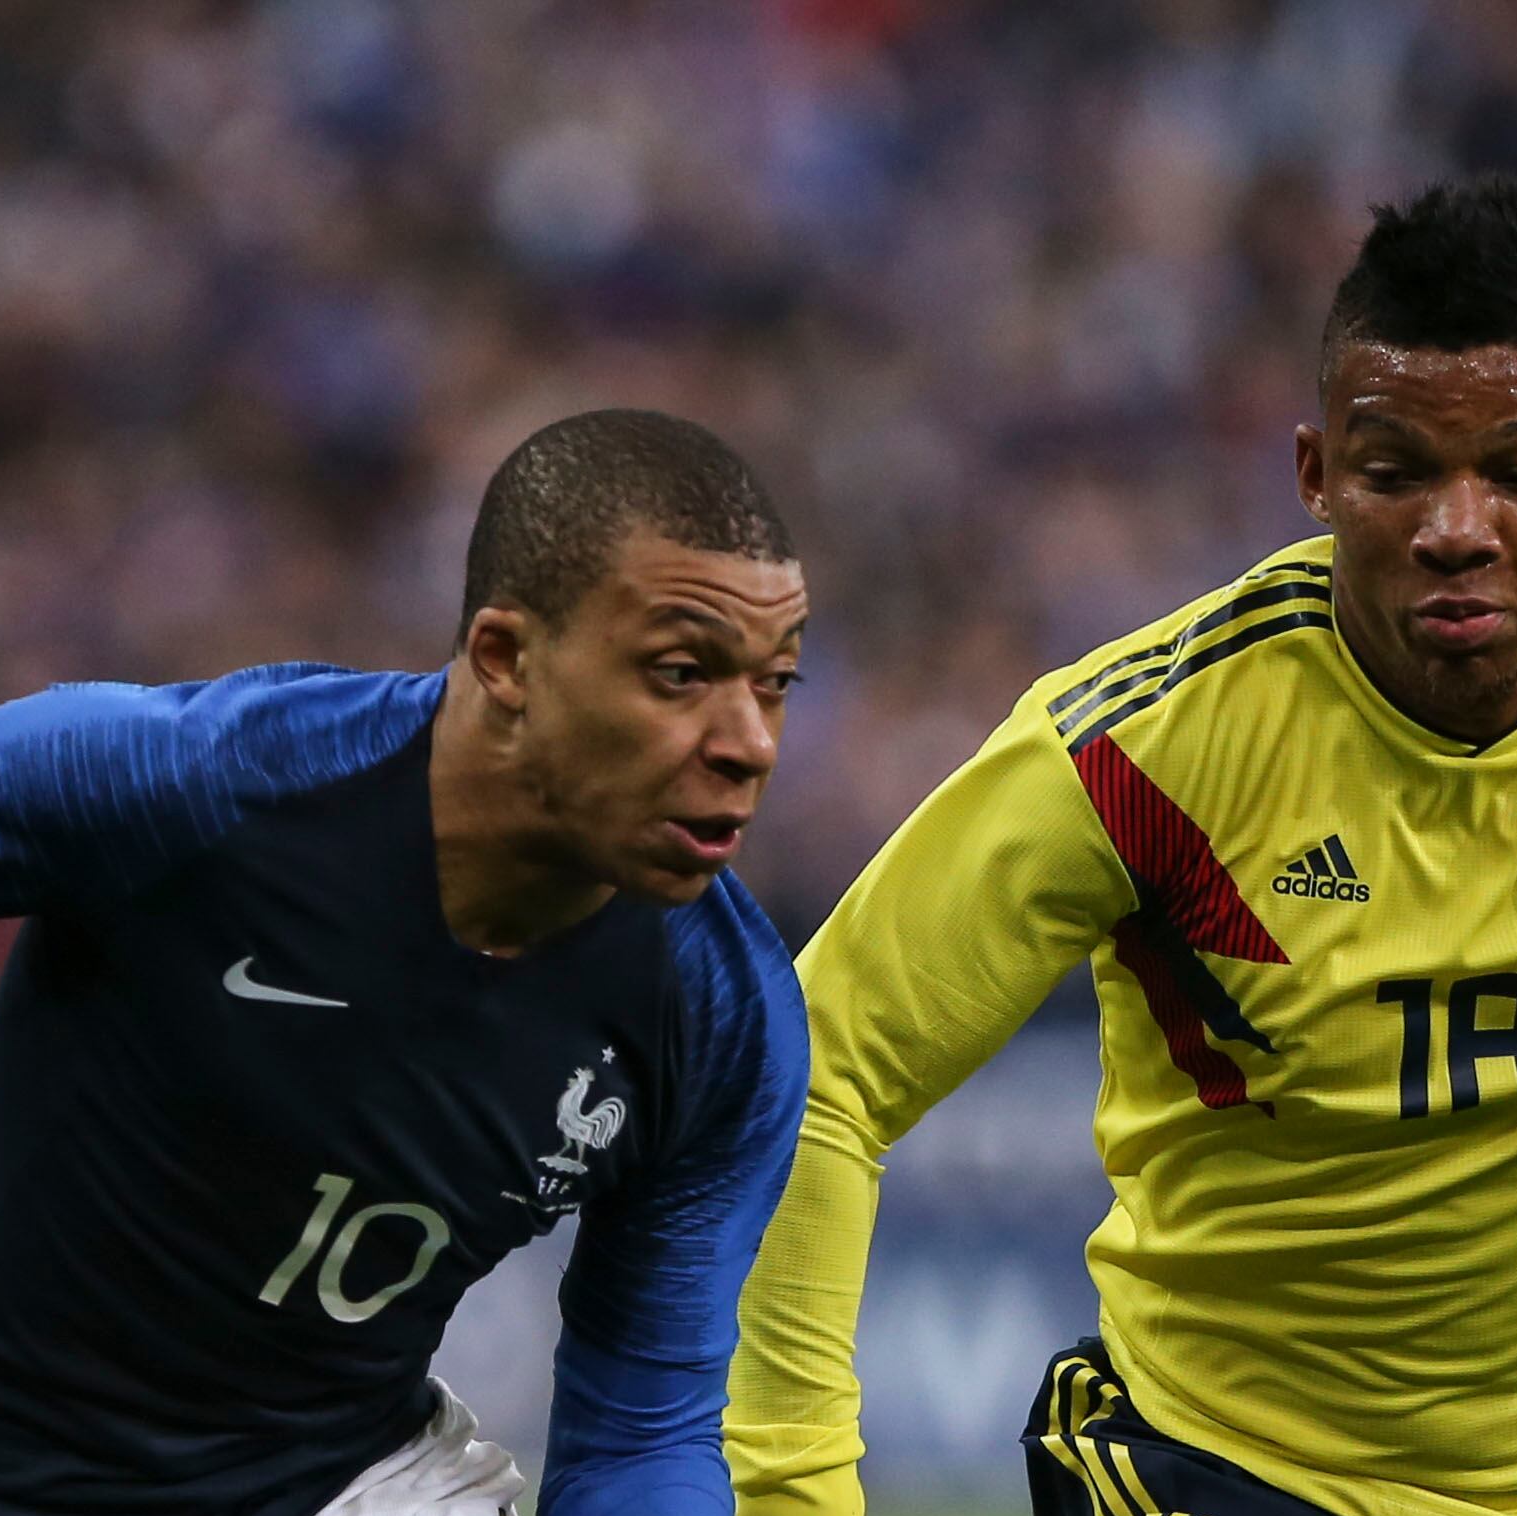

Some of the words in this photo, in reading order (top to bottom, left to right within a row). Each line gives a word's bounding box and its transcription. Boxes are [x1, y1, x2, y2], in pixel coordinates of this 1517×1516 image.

[1271, 873, 1371, 903] adidas
[538, 1176, 572, 1195] FFF
[258, 1172, 451, 1323] 10
